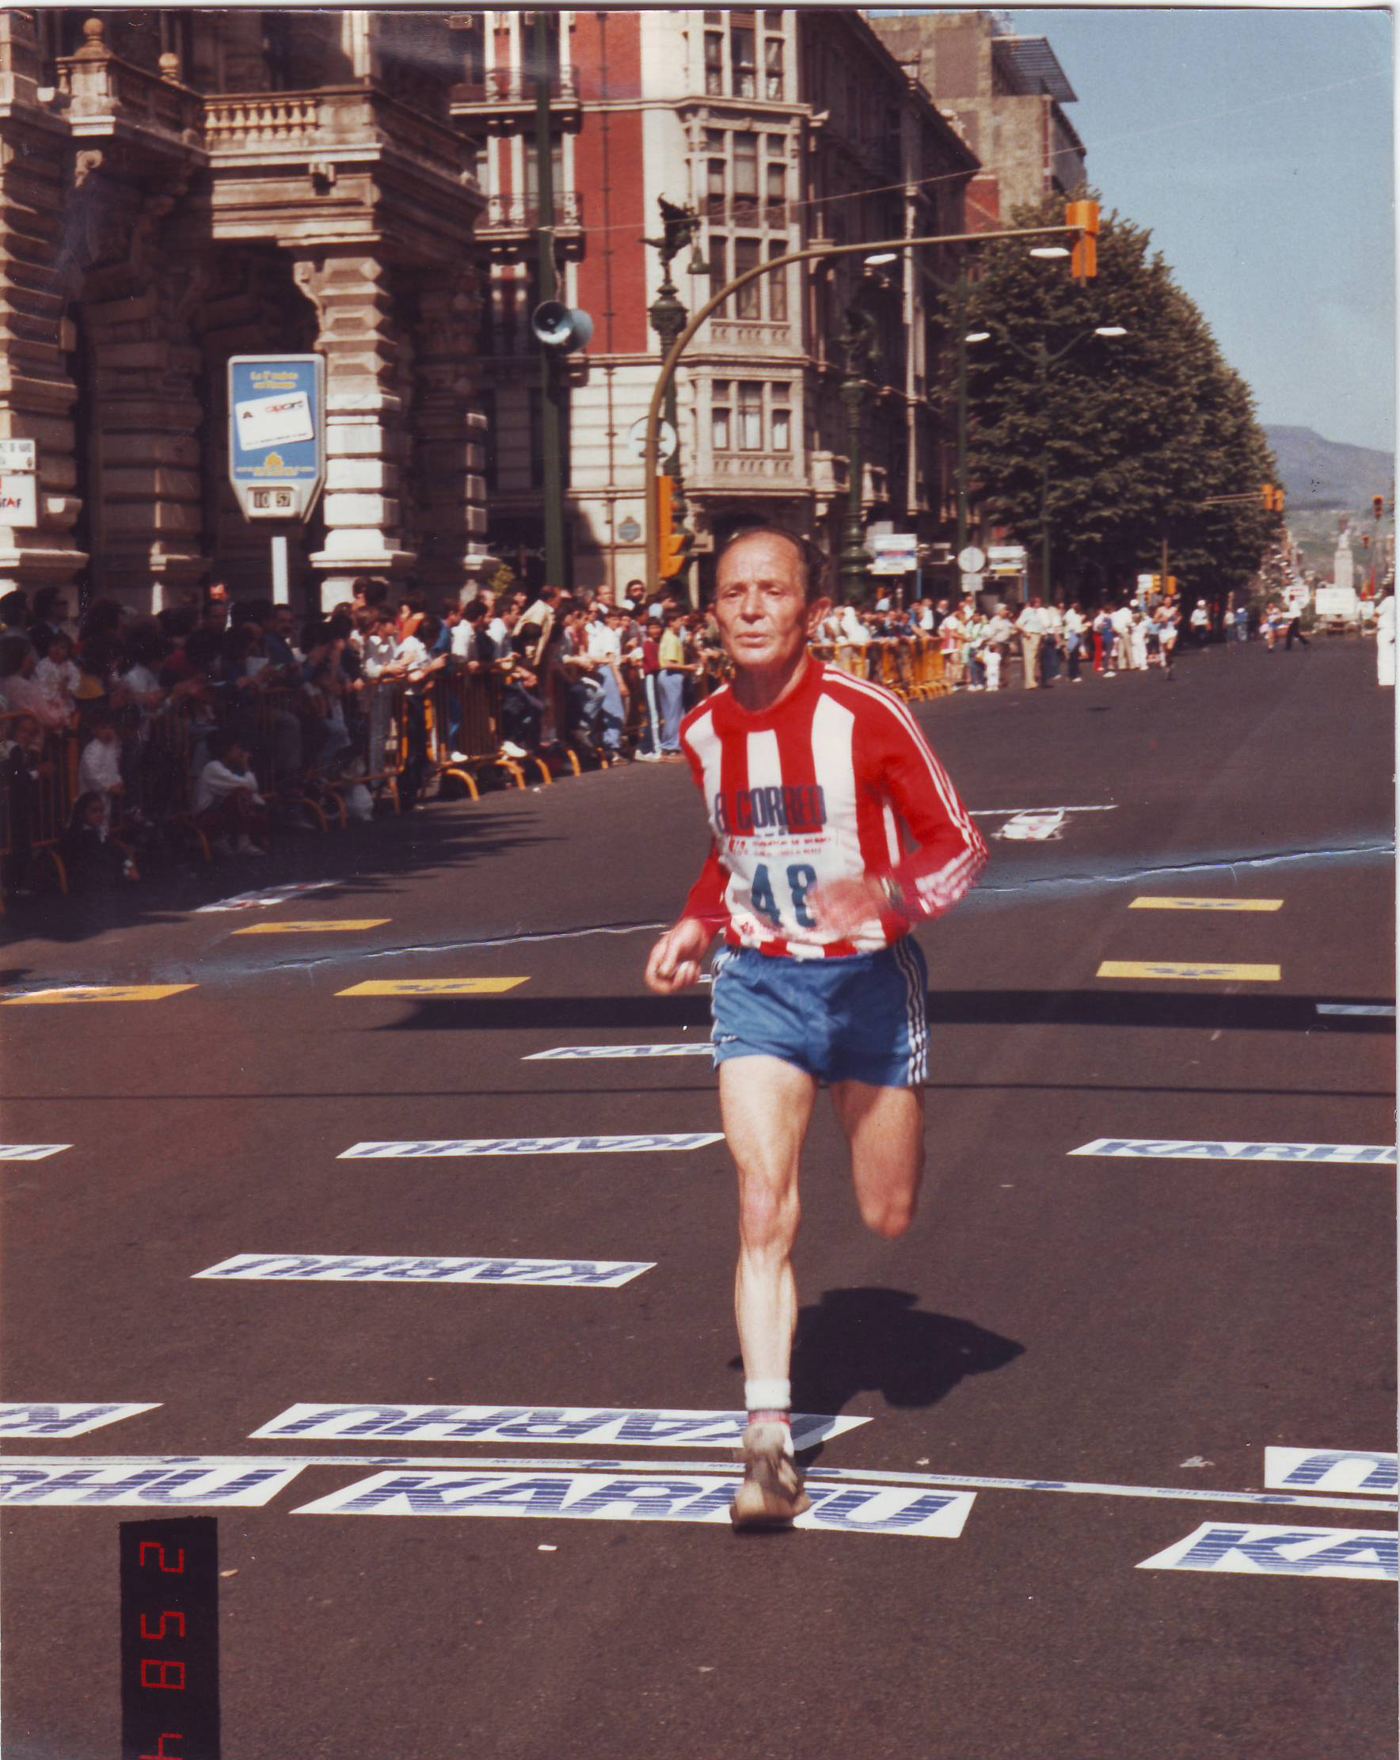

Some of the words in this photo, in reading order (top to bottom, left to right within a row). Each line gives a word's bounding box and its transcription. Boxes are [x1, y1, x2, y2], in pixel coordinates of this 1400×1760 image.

[751, 863, 818, 928] 48
[1094, 1141, 1397, 1161] KARH
[210, 1256, 645, 1283] KARHU
